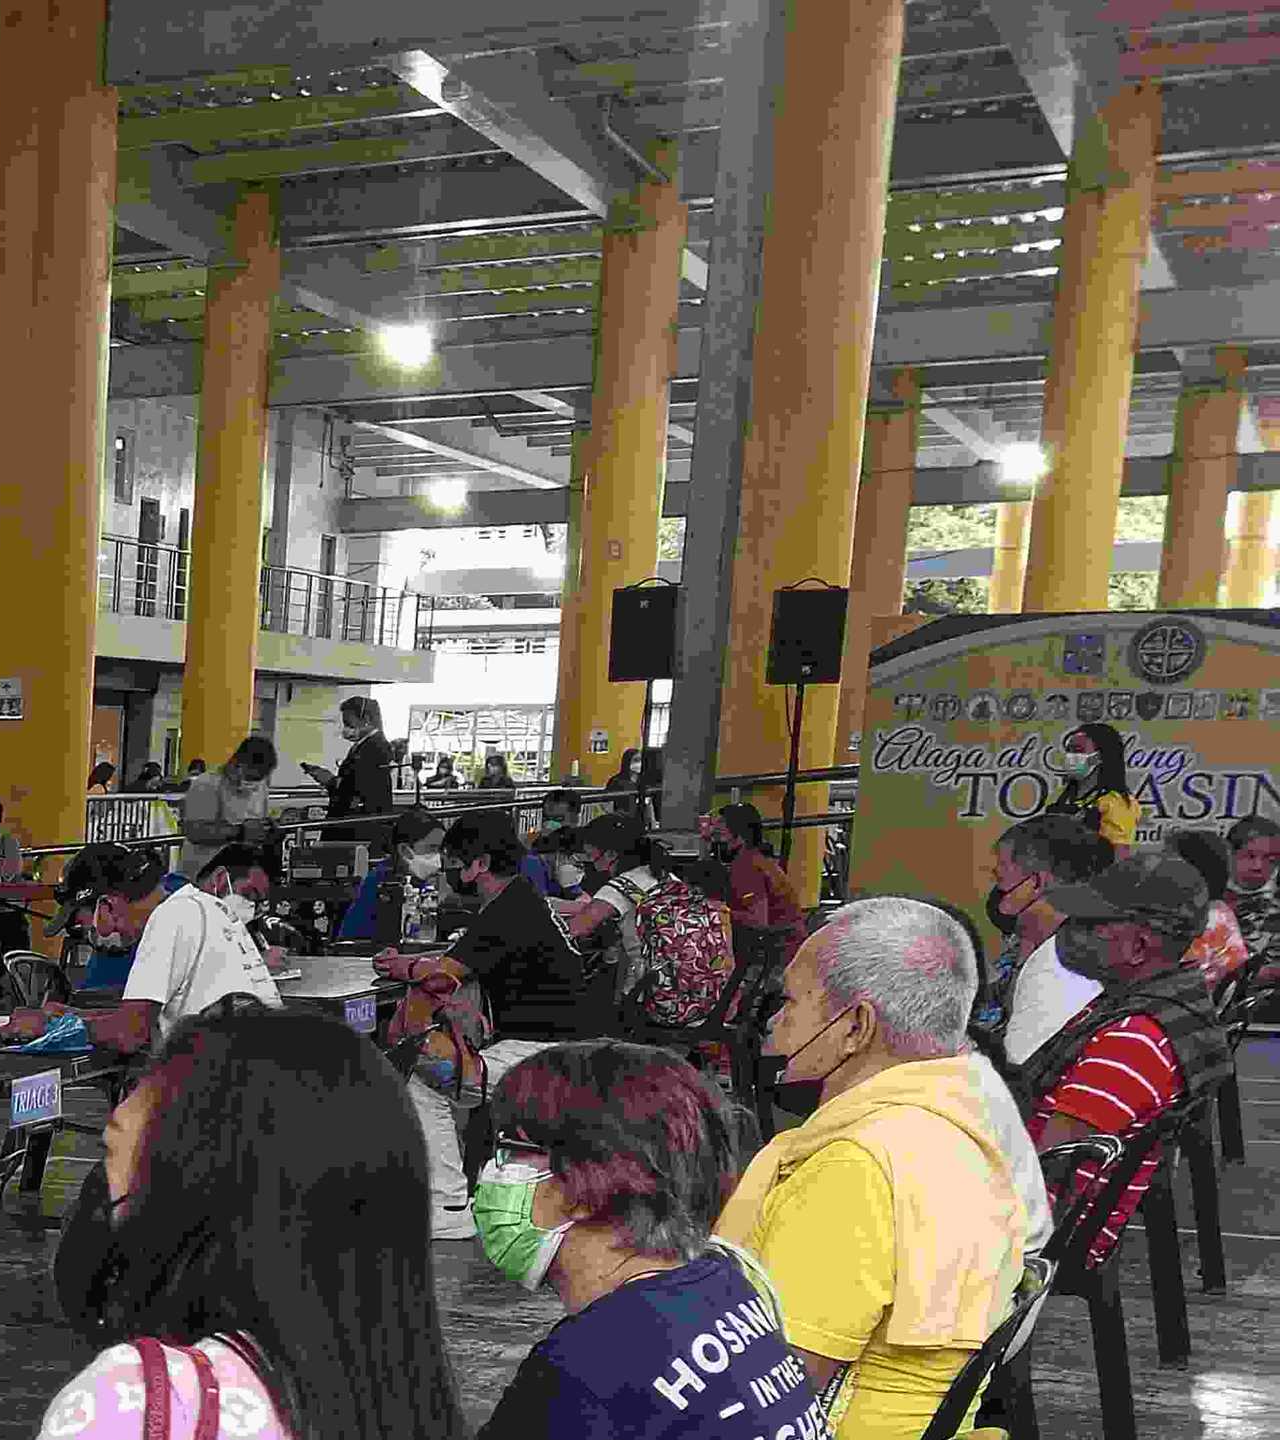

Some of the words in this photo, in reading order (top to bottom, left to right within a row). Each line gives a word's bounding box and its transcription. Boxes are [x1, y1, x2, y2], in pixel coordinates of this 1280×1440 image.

[874, 727, 986, 783] Alaga
[997, 736, 1038, 768] at
[14, 1086, 49, 1114] TRIAGE
[750, 1375, 781, 1408] IN
[771, 1355, 806, 1393] THE
